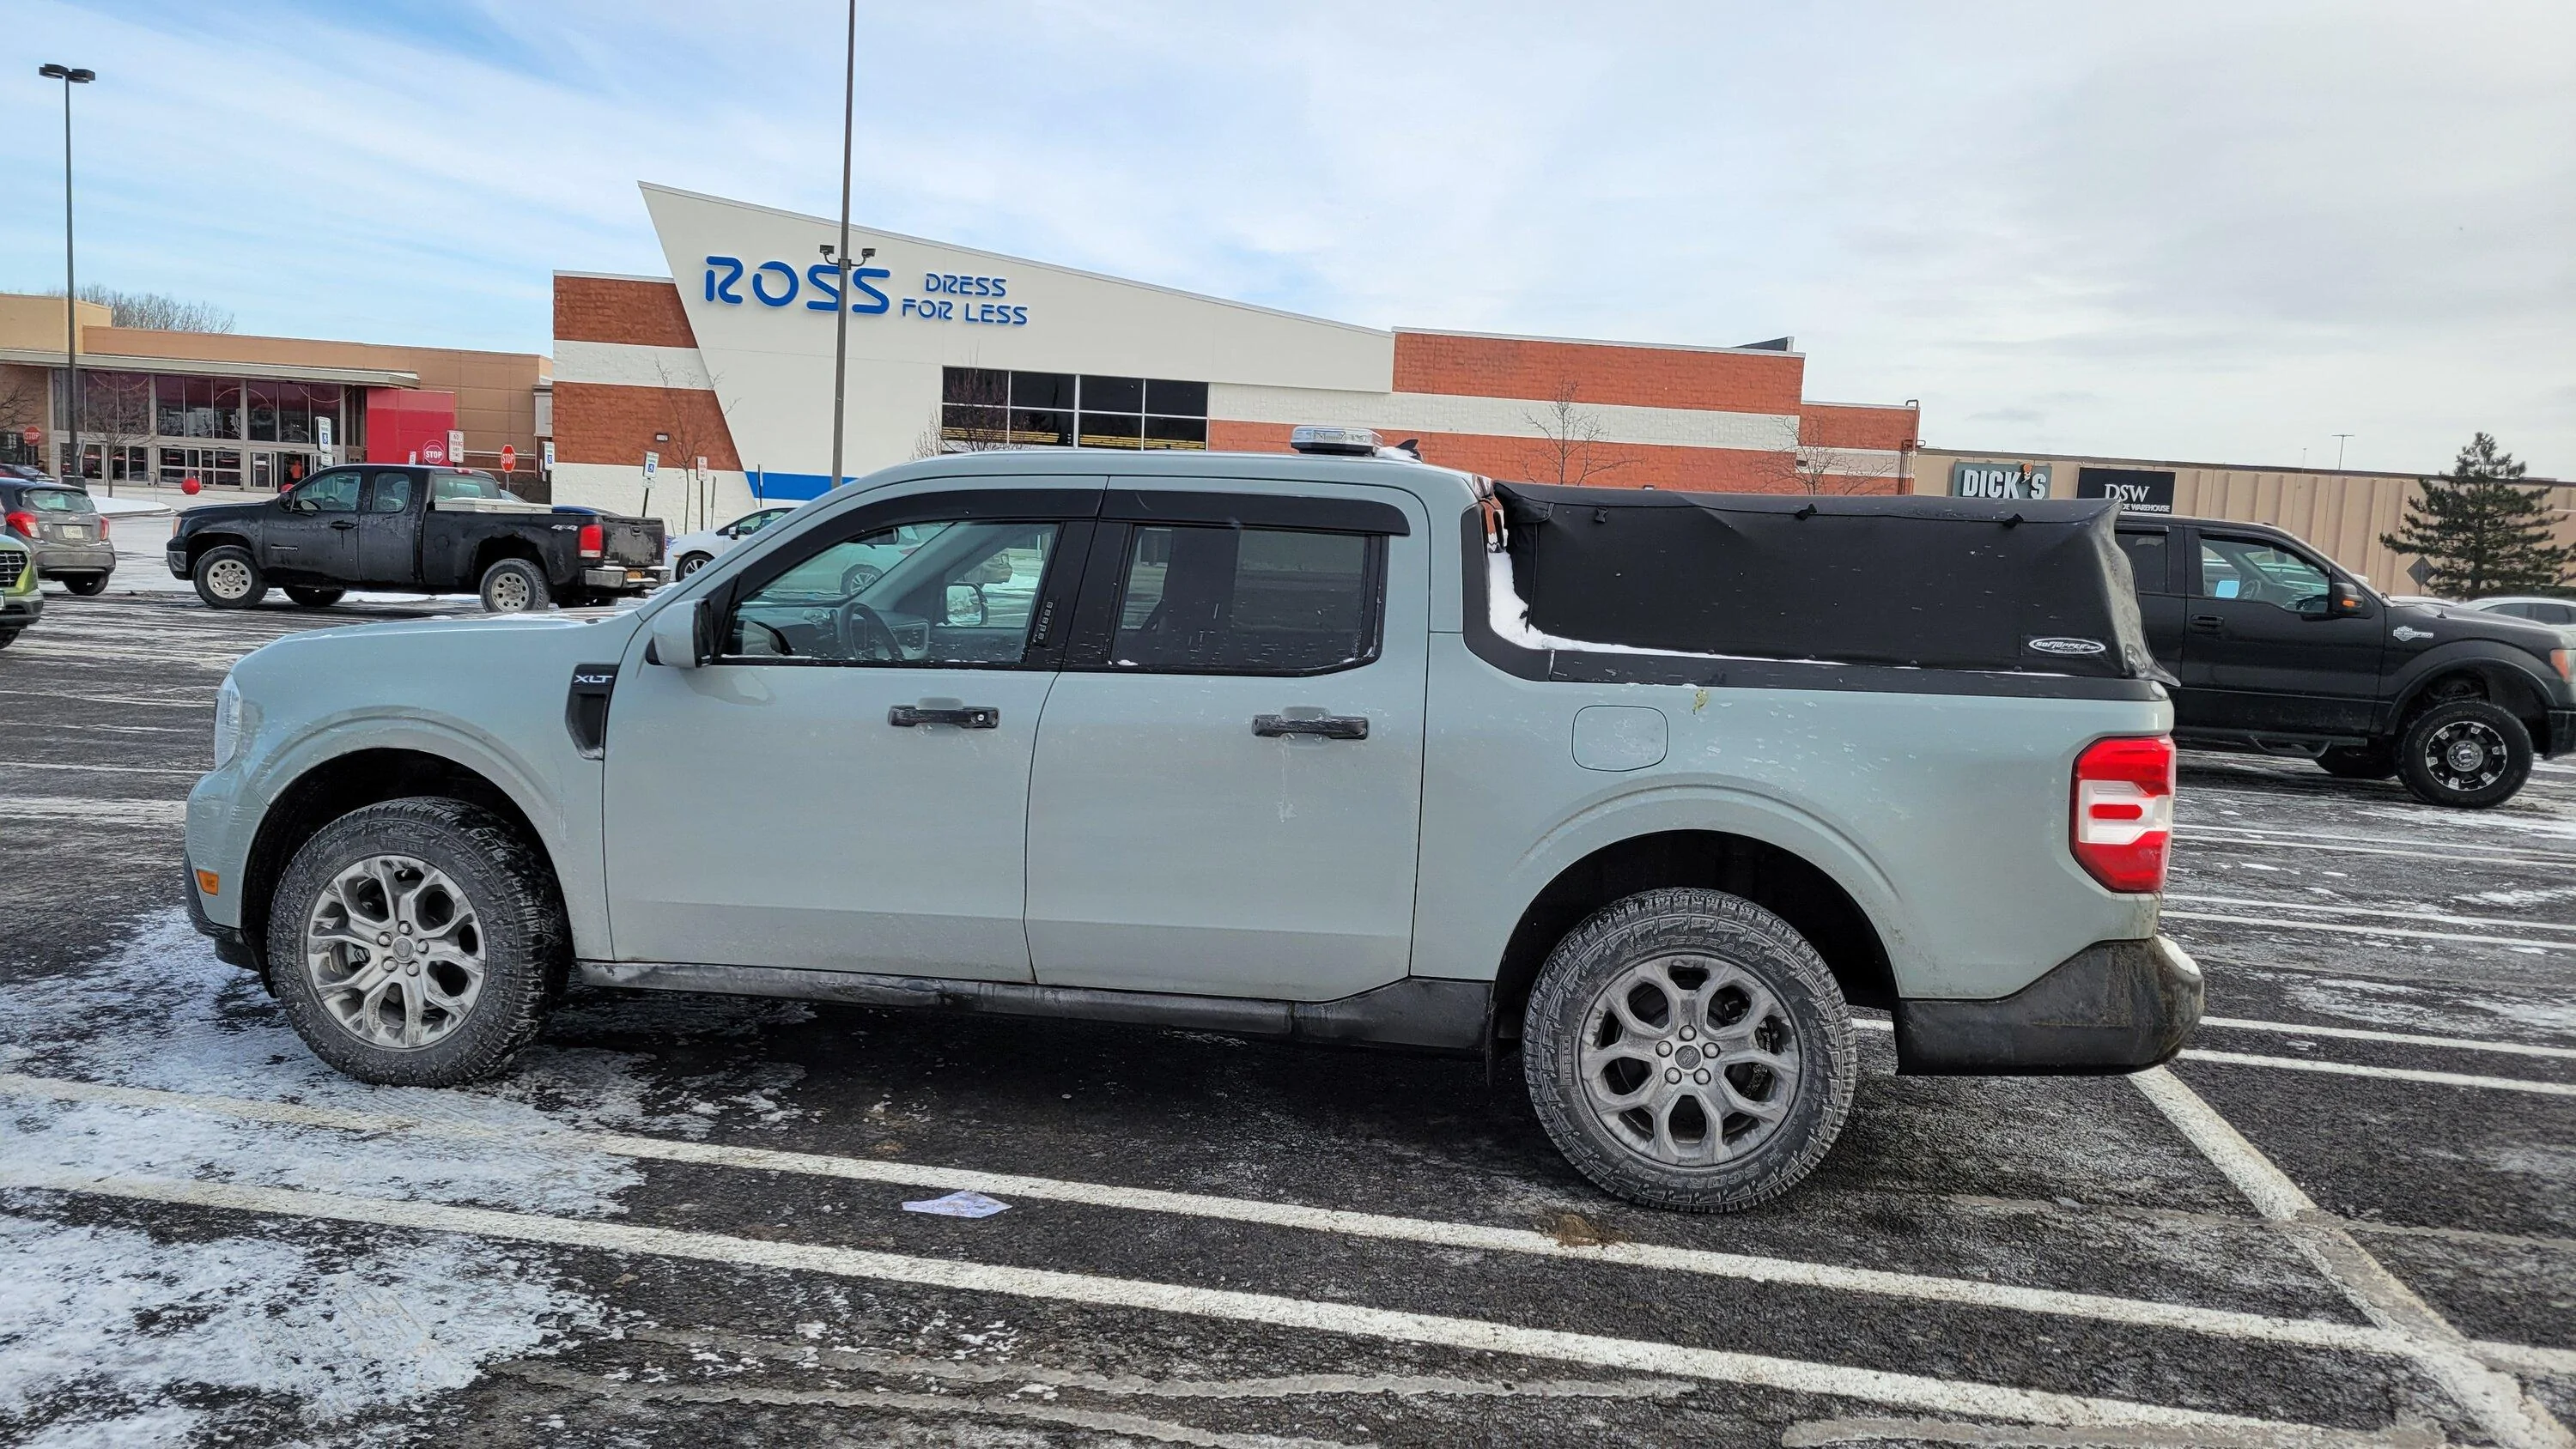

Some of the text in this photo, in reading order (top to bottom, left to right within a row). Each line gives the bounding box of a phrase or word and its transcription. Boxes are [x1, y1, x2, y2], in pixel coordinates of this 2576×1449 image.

[705, 255, 891, 315] ROSS
[926, 273, 1006, 297] DRESS
[902, 298, 1028, 325] FOR LESS
[501, 453, 514, 464] STOP
[1962, 469, 2047, 500] DICK'S
[2105, 483, 2150, 502] DSW
[2130, 503, 2170, 512] WAREHOUSE
[574, 675, 614, 683] XLT
